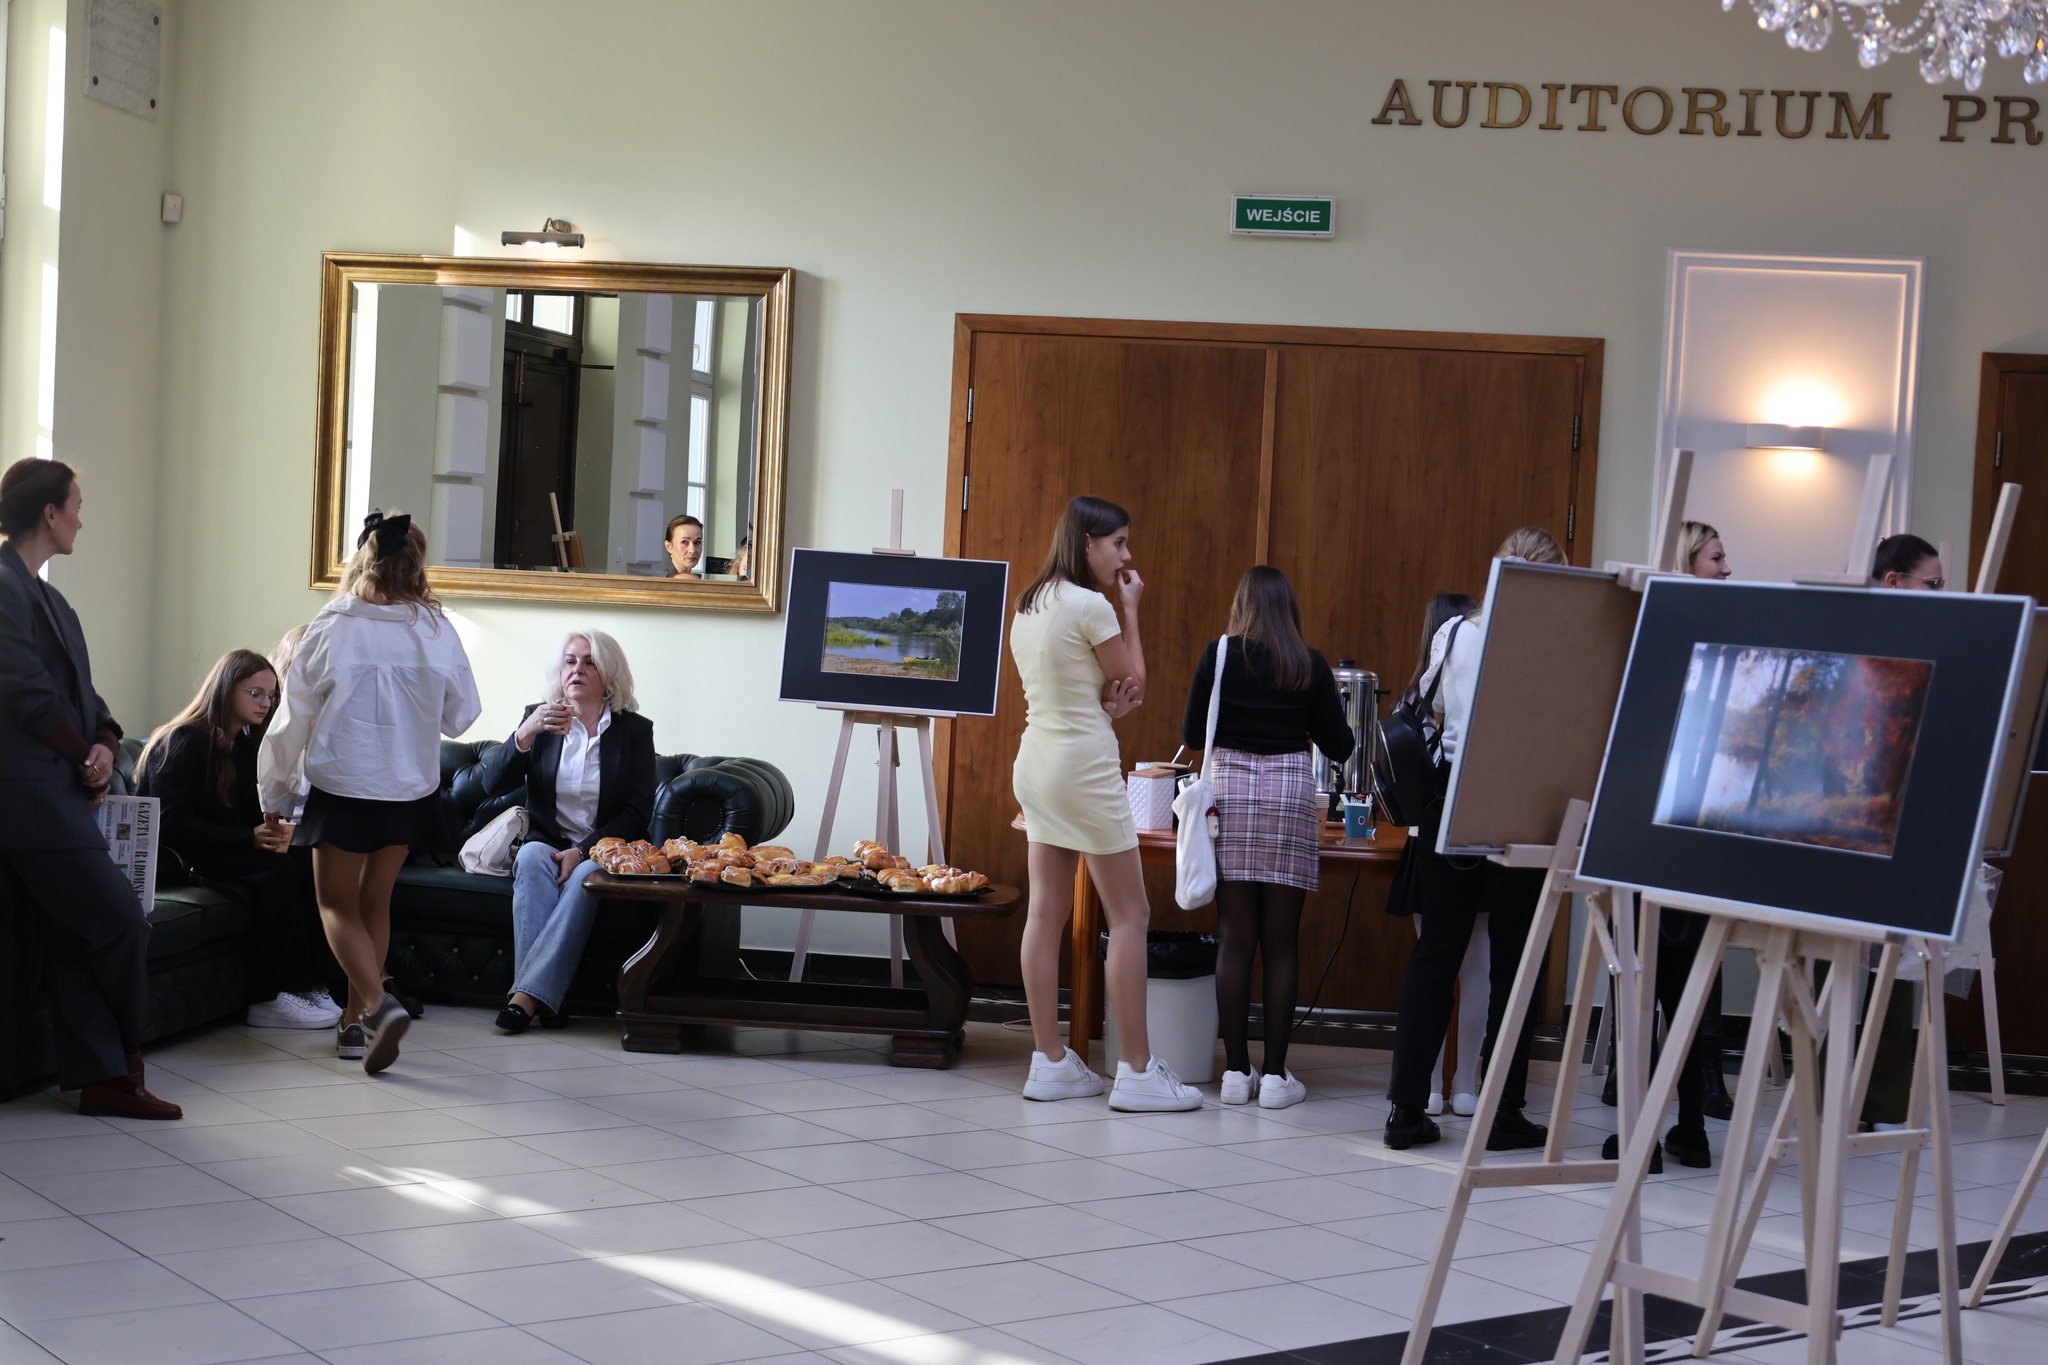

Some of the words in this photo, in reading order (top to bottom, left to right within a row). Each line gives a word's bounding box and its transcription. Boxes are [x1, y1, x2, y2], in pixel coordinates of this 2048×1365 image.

[1371, 78, 1893, 140] AUDITORIUM
[1939, 94, 2044, 146] PR
[1246, 207, 1321, 223] WEJŚCIE
[136, 802, 152, 836] GAZETA
